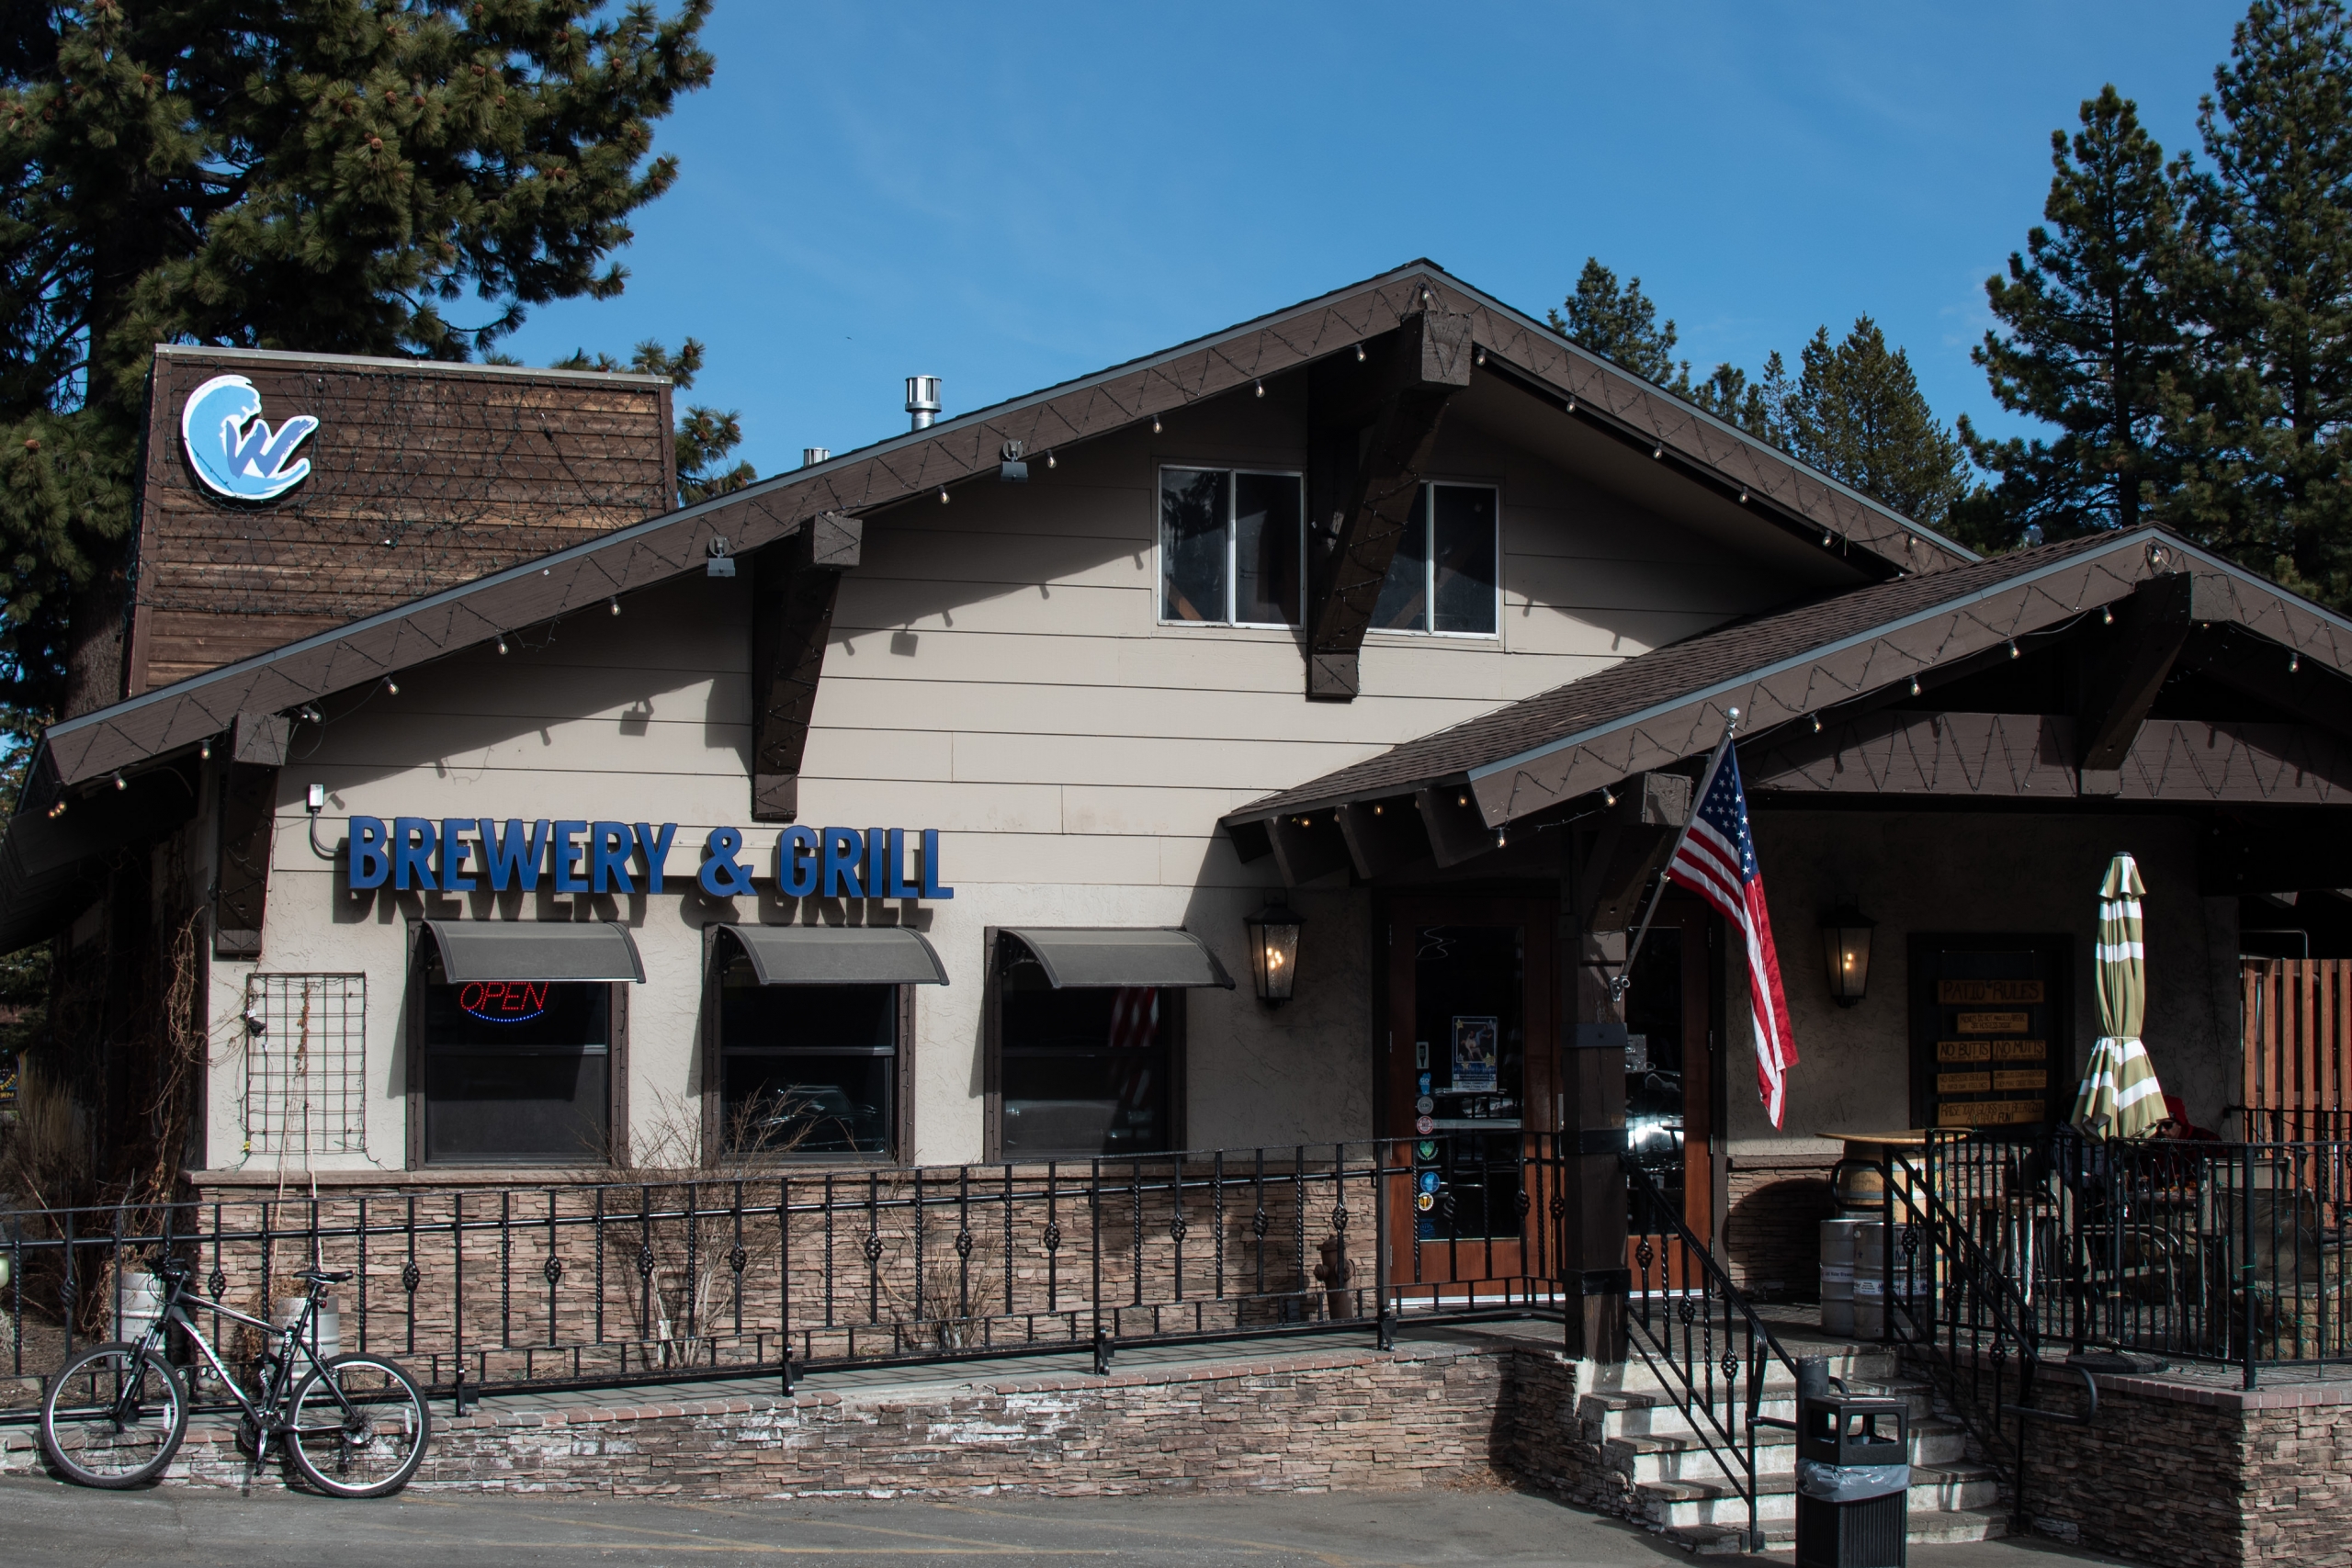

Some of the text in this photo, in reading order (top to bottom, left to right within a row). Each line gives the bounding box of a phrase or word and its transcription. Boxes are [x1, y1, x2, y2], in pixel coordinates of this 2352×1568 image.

[347, 815, 955, 899] BREWERY & GRILL
[459, 981, 548, 1010] OPEN
[1943, 981, 2039, 1000] PATIO RULES
[1939, 1043, 1989, 1056] NO BUTTS
[1996, 1041, 2044, 1055] NO MUTTS
[1940, 1103, 1962, 1117] RAISE
[1976, 1103, 1997, 1114] GLASS
